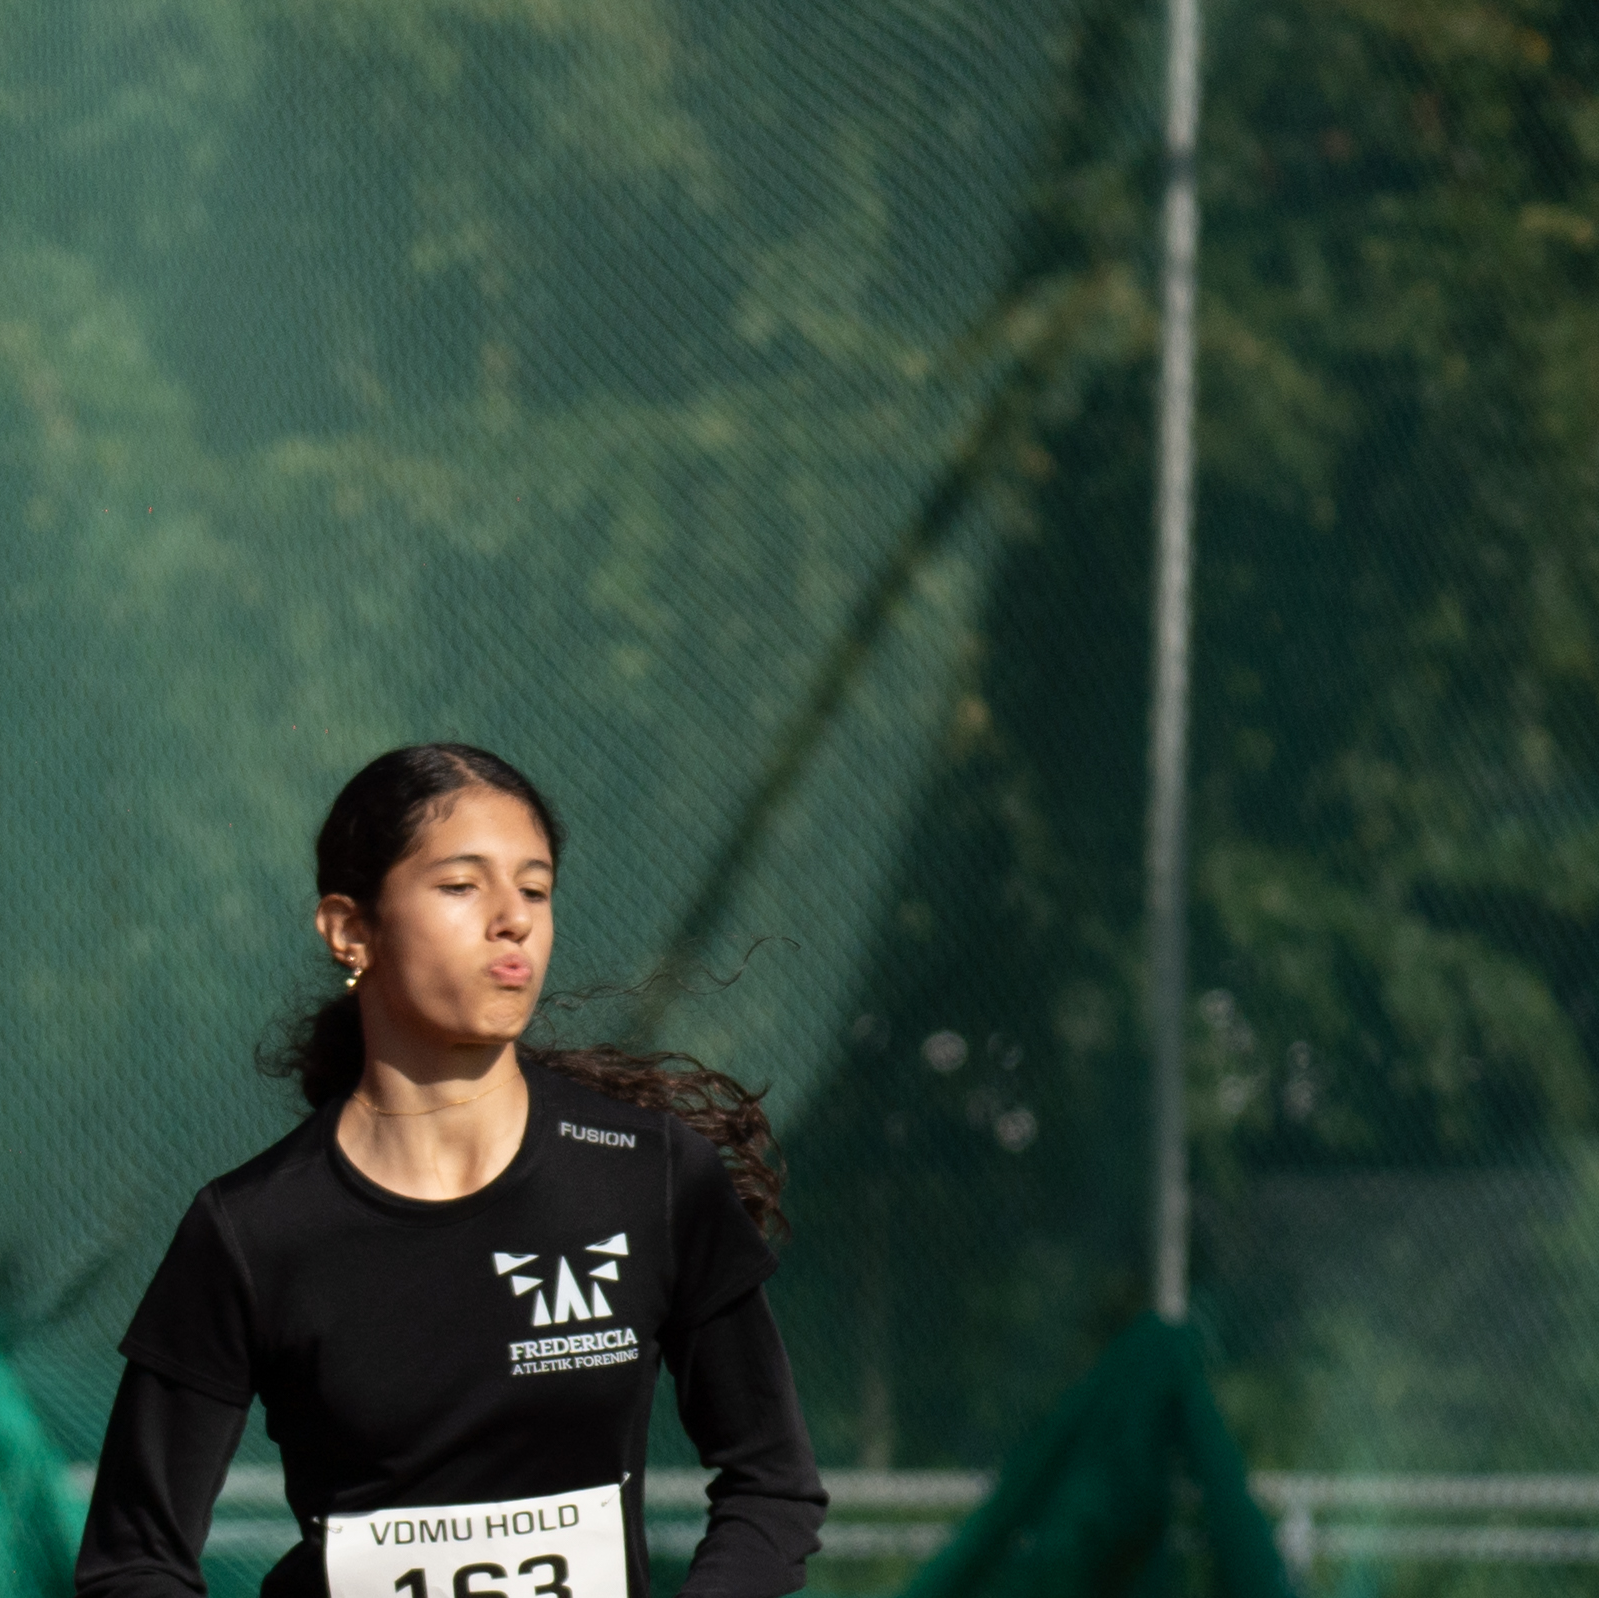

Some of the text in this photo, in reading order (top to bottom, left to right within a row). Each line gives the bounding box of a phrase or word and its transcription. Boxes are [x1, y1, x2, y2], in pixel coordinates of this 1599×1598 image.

[560, 1121, 636, 1148] FUSION
[509, 1328, 638, 1361] FREDERICIA
[512, 1348, 639, 1376] ATLETIK FORENING
[369, 1503, 580, 1546] VDMU HOLD
